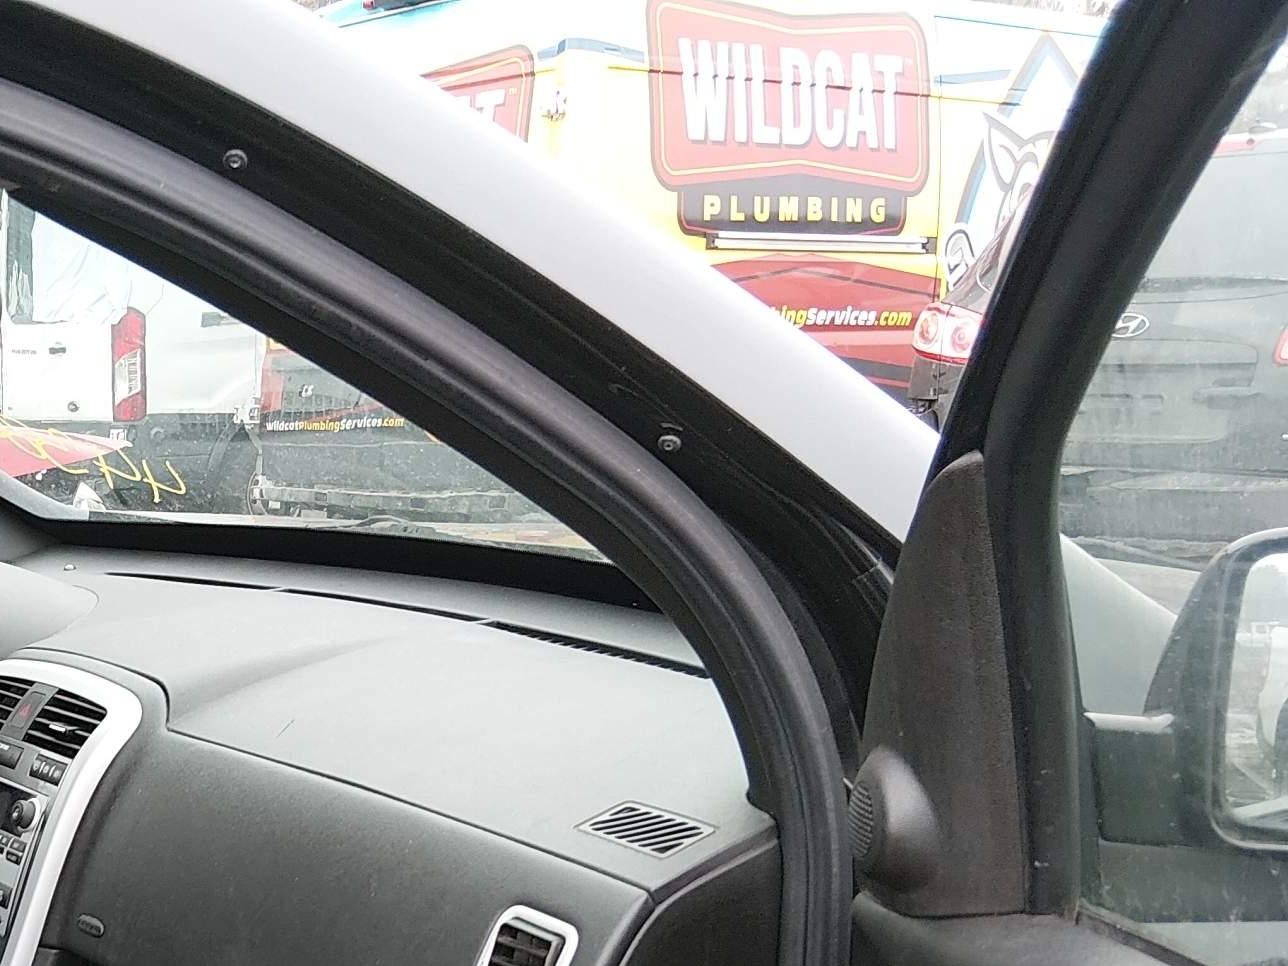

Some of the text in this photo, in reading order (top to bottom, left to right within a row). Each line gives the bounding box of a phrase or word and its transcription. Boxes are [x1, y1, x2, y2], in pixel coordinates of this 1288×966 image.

[678, 37, 904, 150] WILDCAT
[703, 194, 887, 224] PLUMBING
[771, 304, 912, 328] ingServices.com
